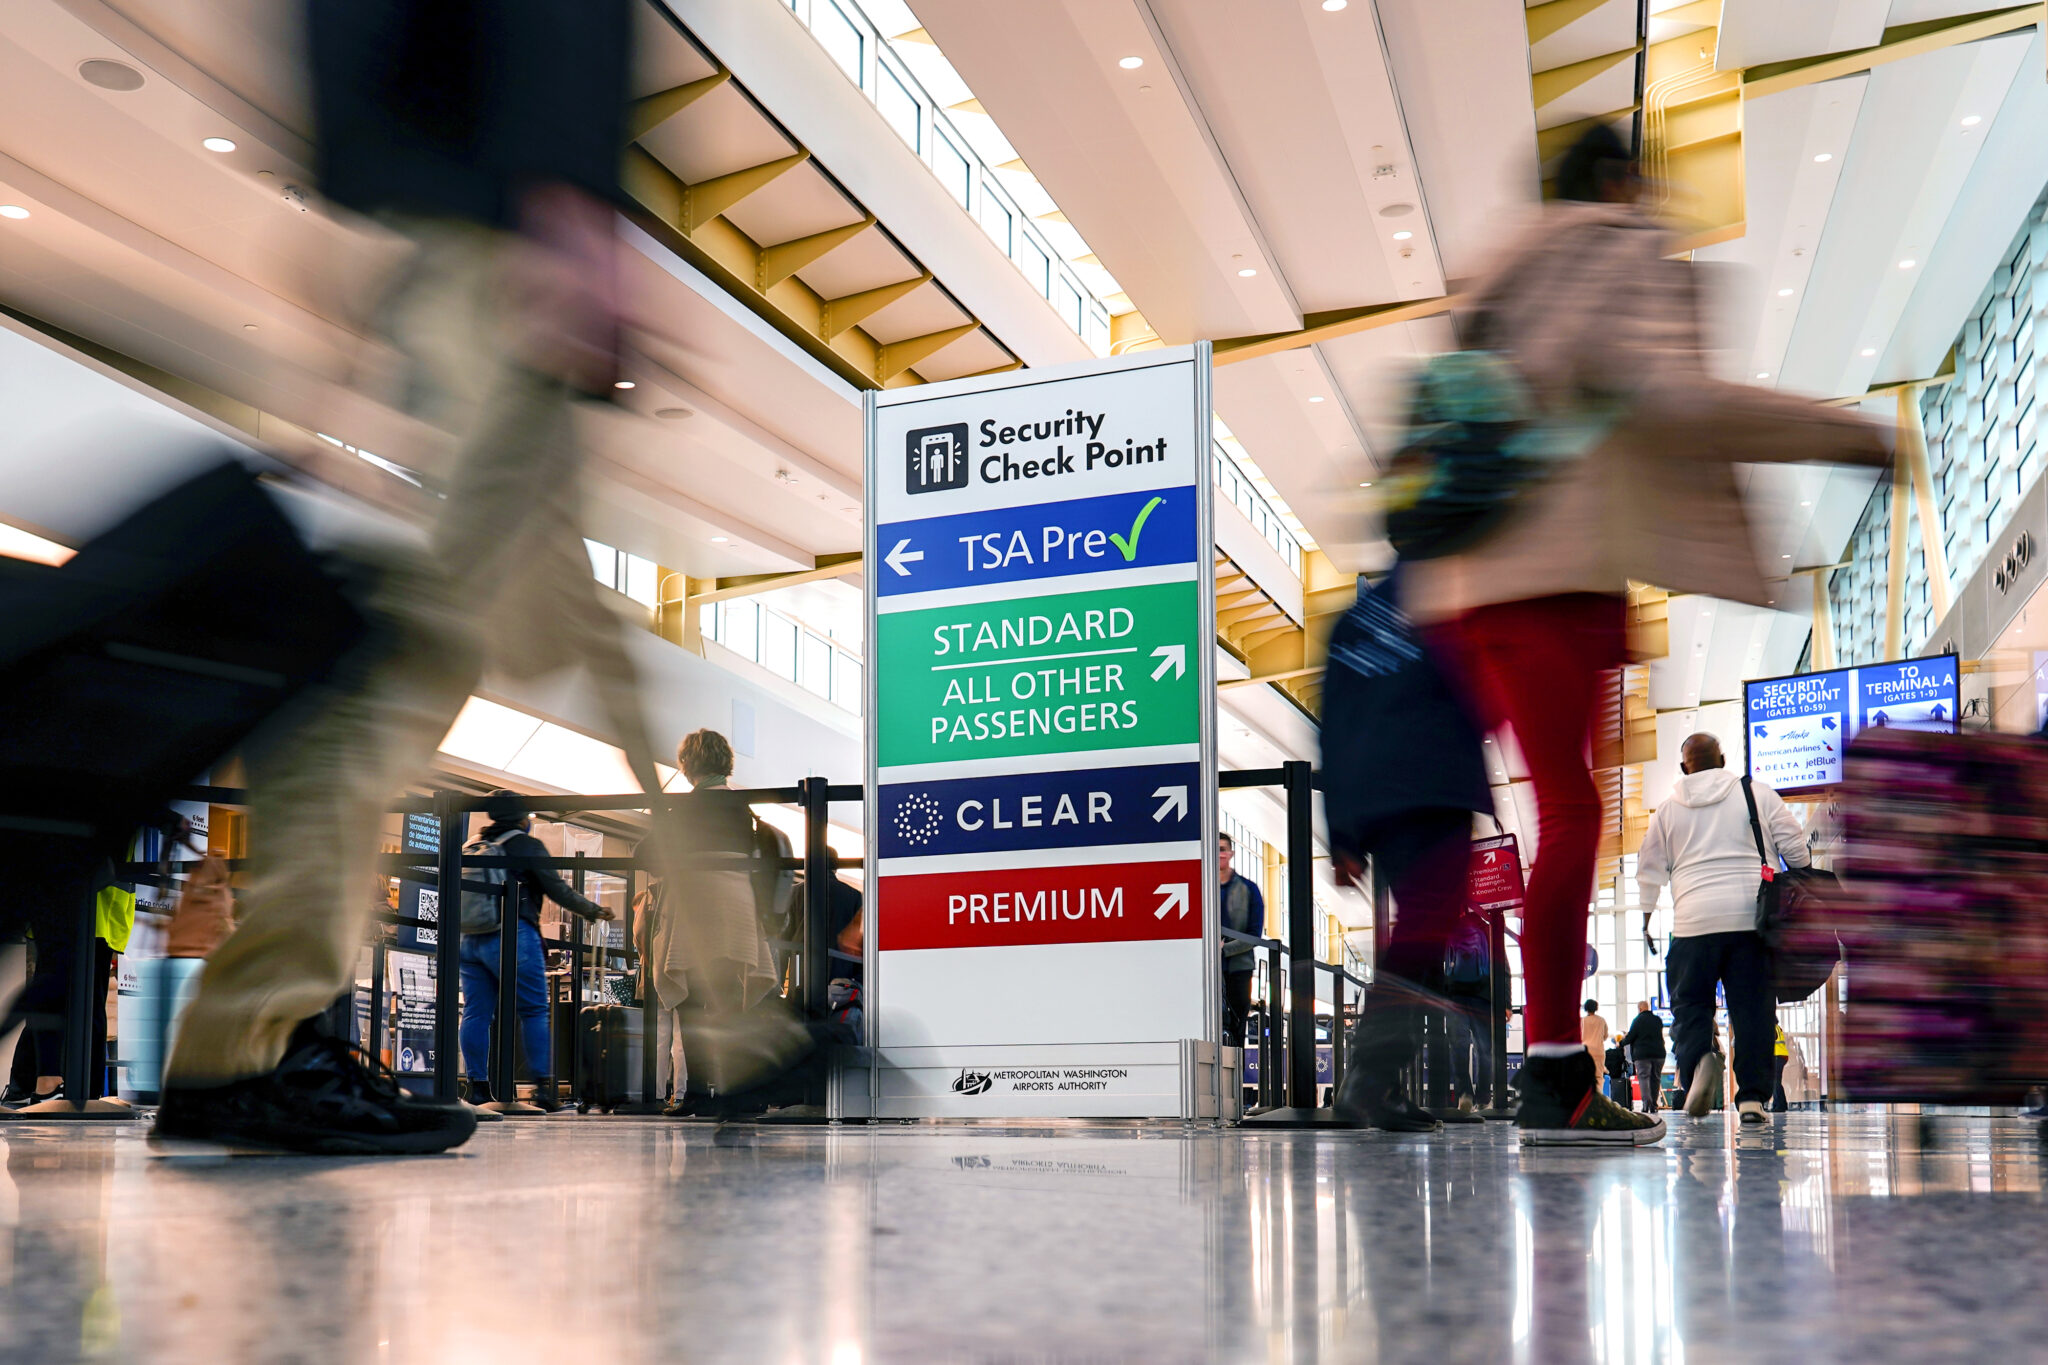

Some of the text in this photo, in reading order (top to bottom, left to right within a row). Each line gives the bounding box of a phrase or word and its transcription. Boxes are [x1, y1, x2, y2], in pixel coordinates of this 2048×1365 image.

[979, 408, 1106, 448] Security
[979, 437, 1167, 484] Check Point
[958, 526, 1107, 572] TSA Pre
[933, 607, 1134, 656] STANDARD
[1898, 665, 1919, 680] TO
[941, 664, 1125, 707] ALL OTHER
[1763, 677, 1827, 698] SECURITY
[1865, 673, 1954, 696] TERMINAL A
[1750, 687, 1841, 711] CHECK POINT
[1883, 688, 1938, 704] (GATES 1-9)
[1766, 702, 1827, 719] (GATES 10-59)
[931, 700, 1138, 744] PASSENGERS
[1757, 744, 1821, 757] American Airlines
[1765, 761, 1800, 772] DELTA
[1805, 756, 1837, 769] jetBlue
[1775, 773, 1815, 783] UNITED
[956, 791, 1113, 831] CLEAR
[1474, 873, 1500, 883] Standard
[1497, 885, 1513, 893] Crew
[948, 886, 1124, 925] PREMIUM
[993, 1069, 1128, 1080] METROPOLITAN WASHINGTON
[1012, 1081, 1108, 1091] AIRPORTS AUTHORITY
